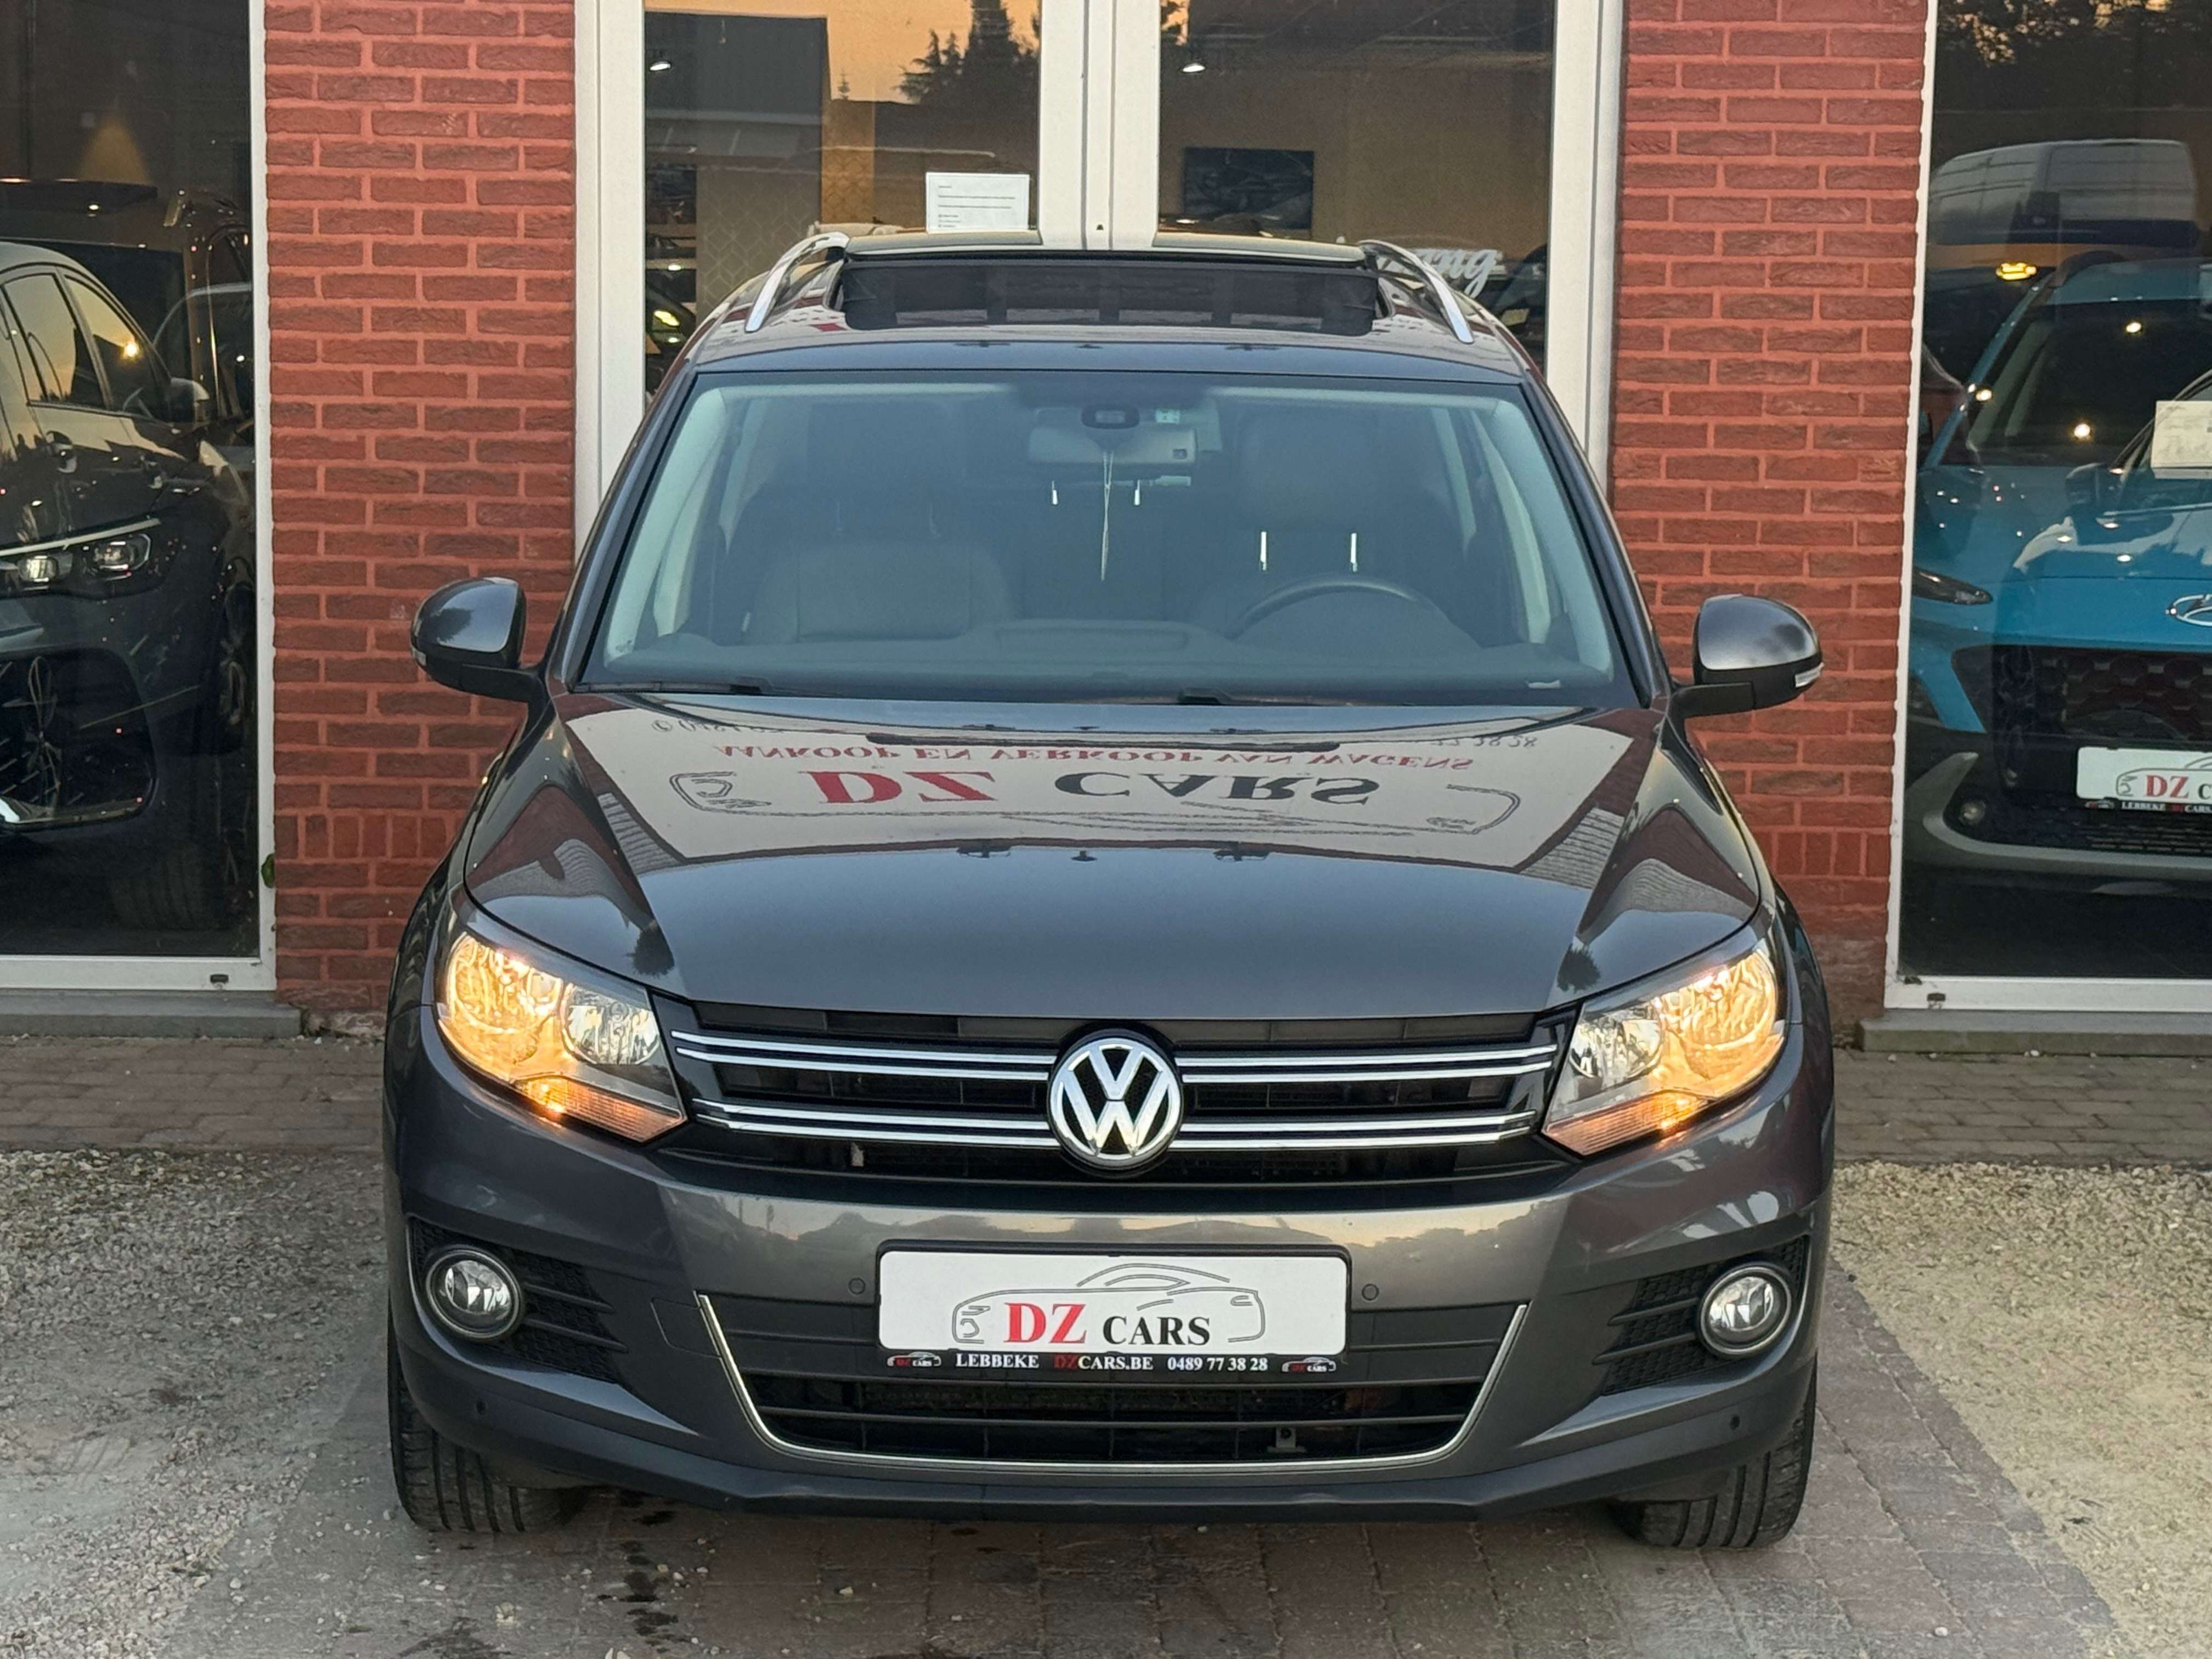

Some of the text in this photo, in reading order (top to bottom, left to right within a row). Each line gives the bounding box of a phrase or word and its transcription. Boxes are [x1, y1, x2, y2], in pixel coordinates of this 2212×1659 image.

[2146, 774, 2190, 799] DZ
[1003, 1302, 1210, 1345] DZ CARS
[956, 1353, 1268, 1372] LEBBEKE DZCARS.BE 0489 77 38 28
